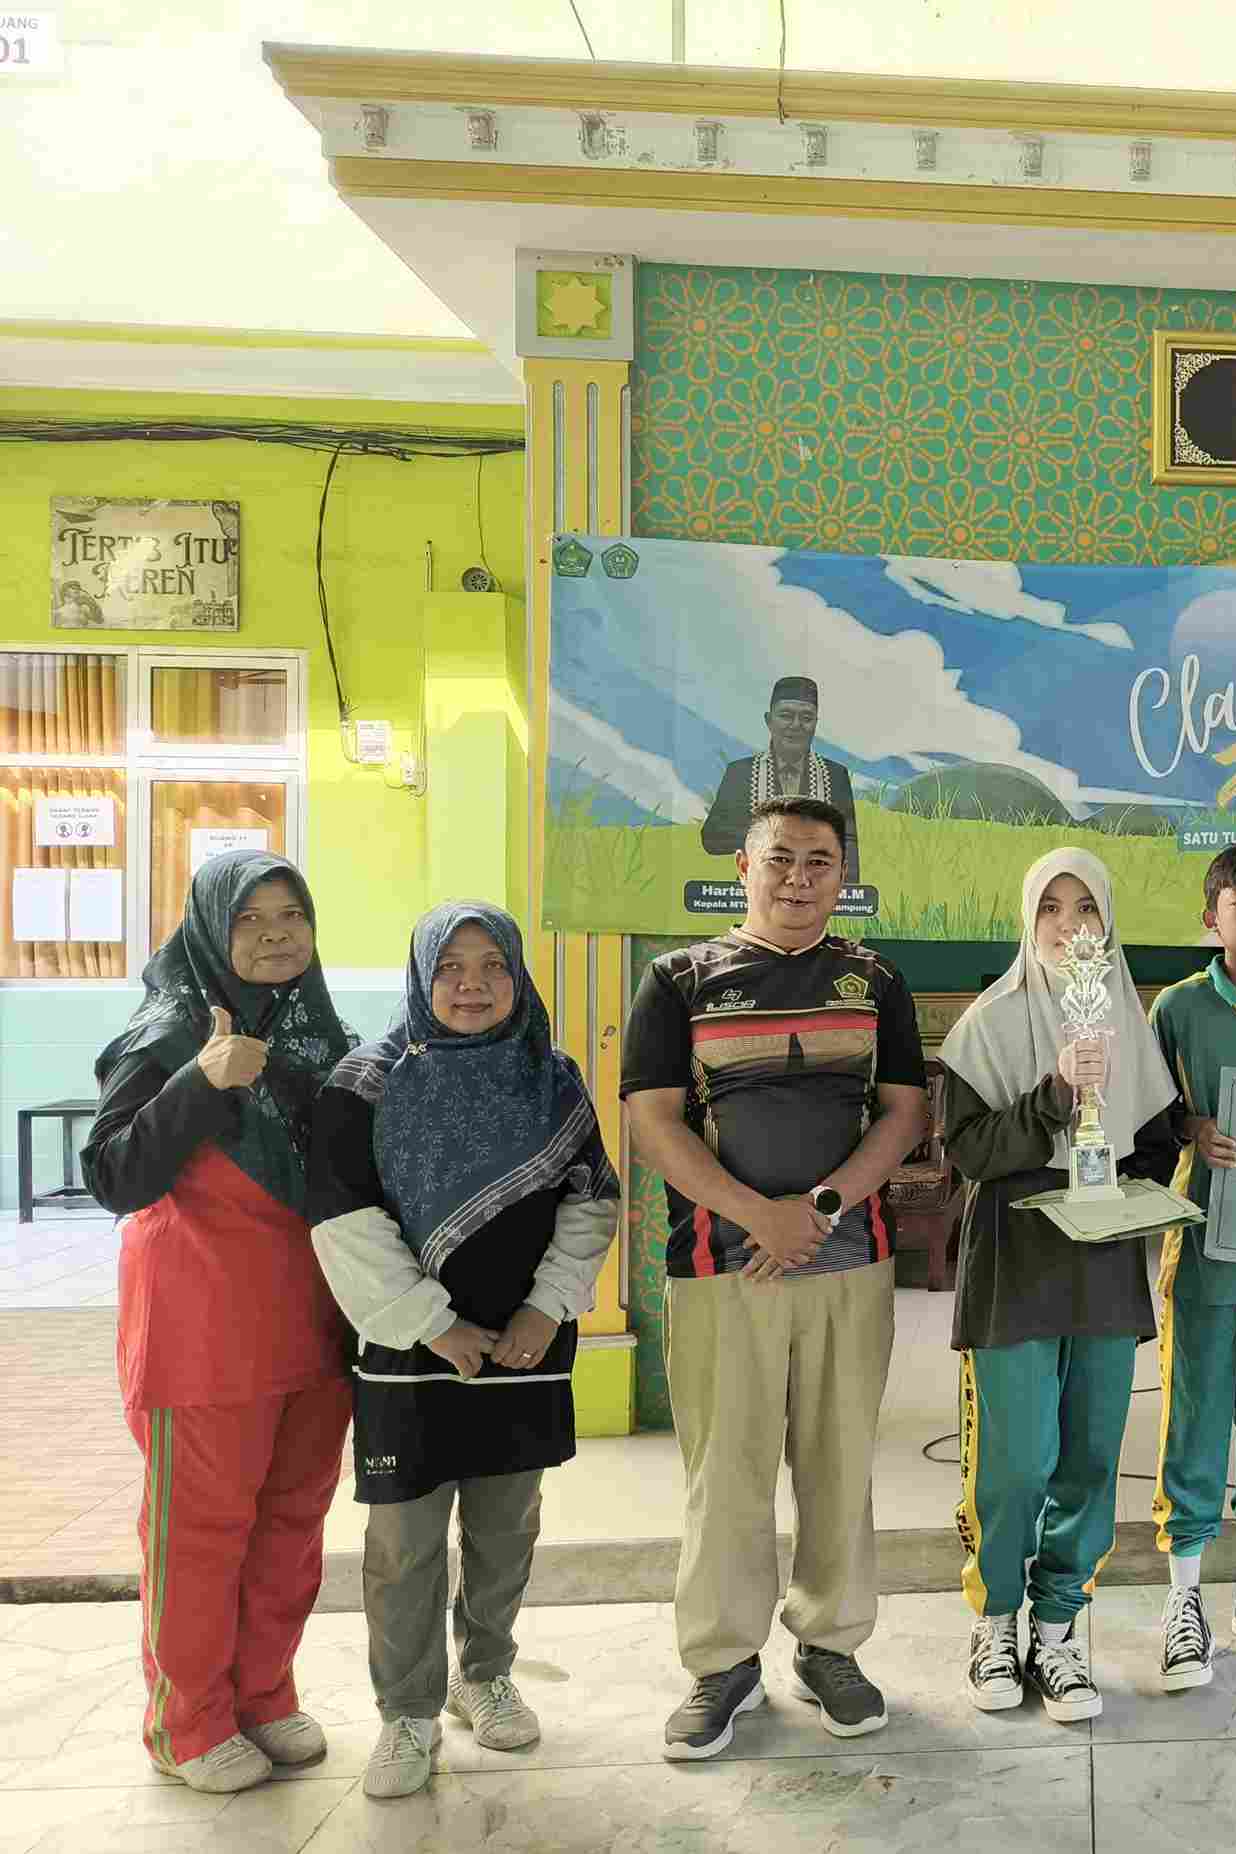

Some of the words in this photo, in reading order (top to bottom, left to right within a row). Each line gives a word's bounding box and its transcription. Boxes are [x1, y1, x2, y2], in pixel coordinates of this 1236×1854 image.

[58, 528, 162, 566] TERTB
[1183, 832, 1218, 845] SATU
[832, 904, 873, 913] ampung
